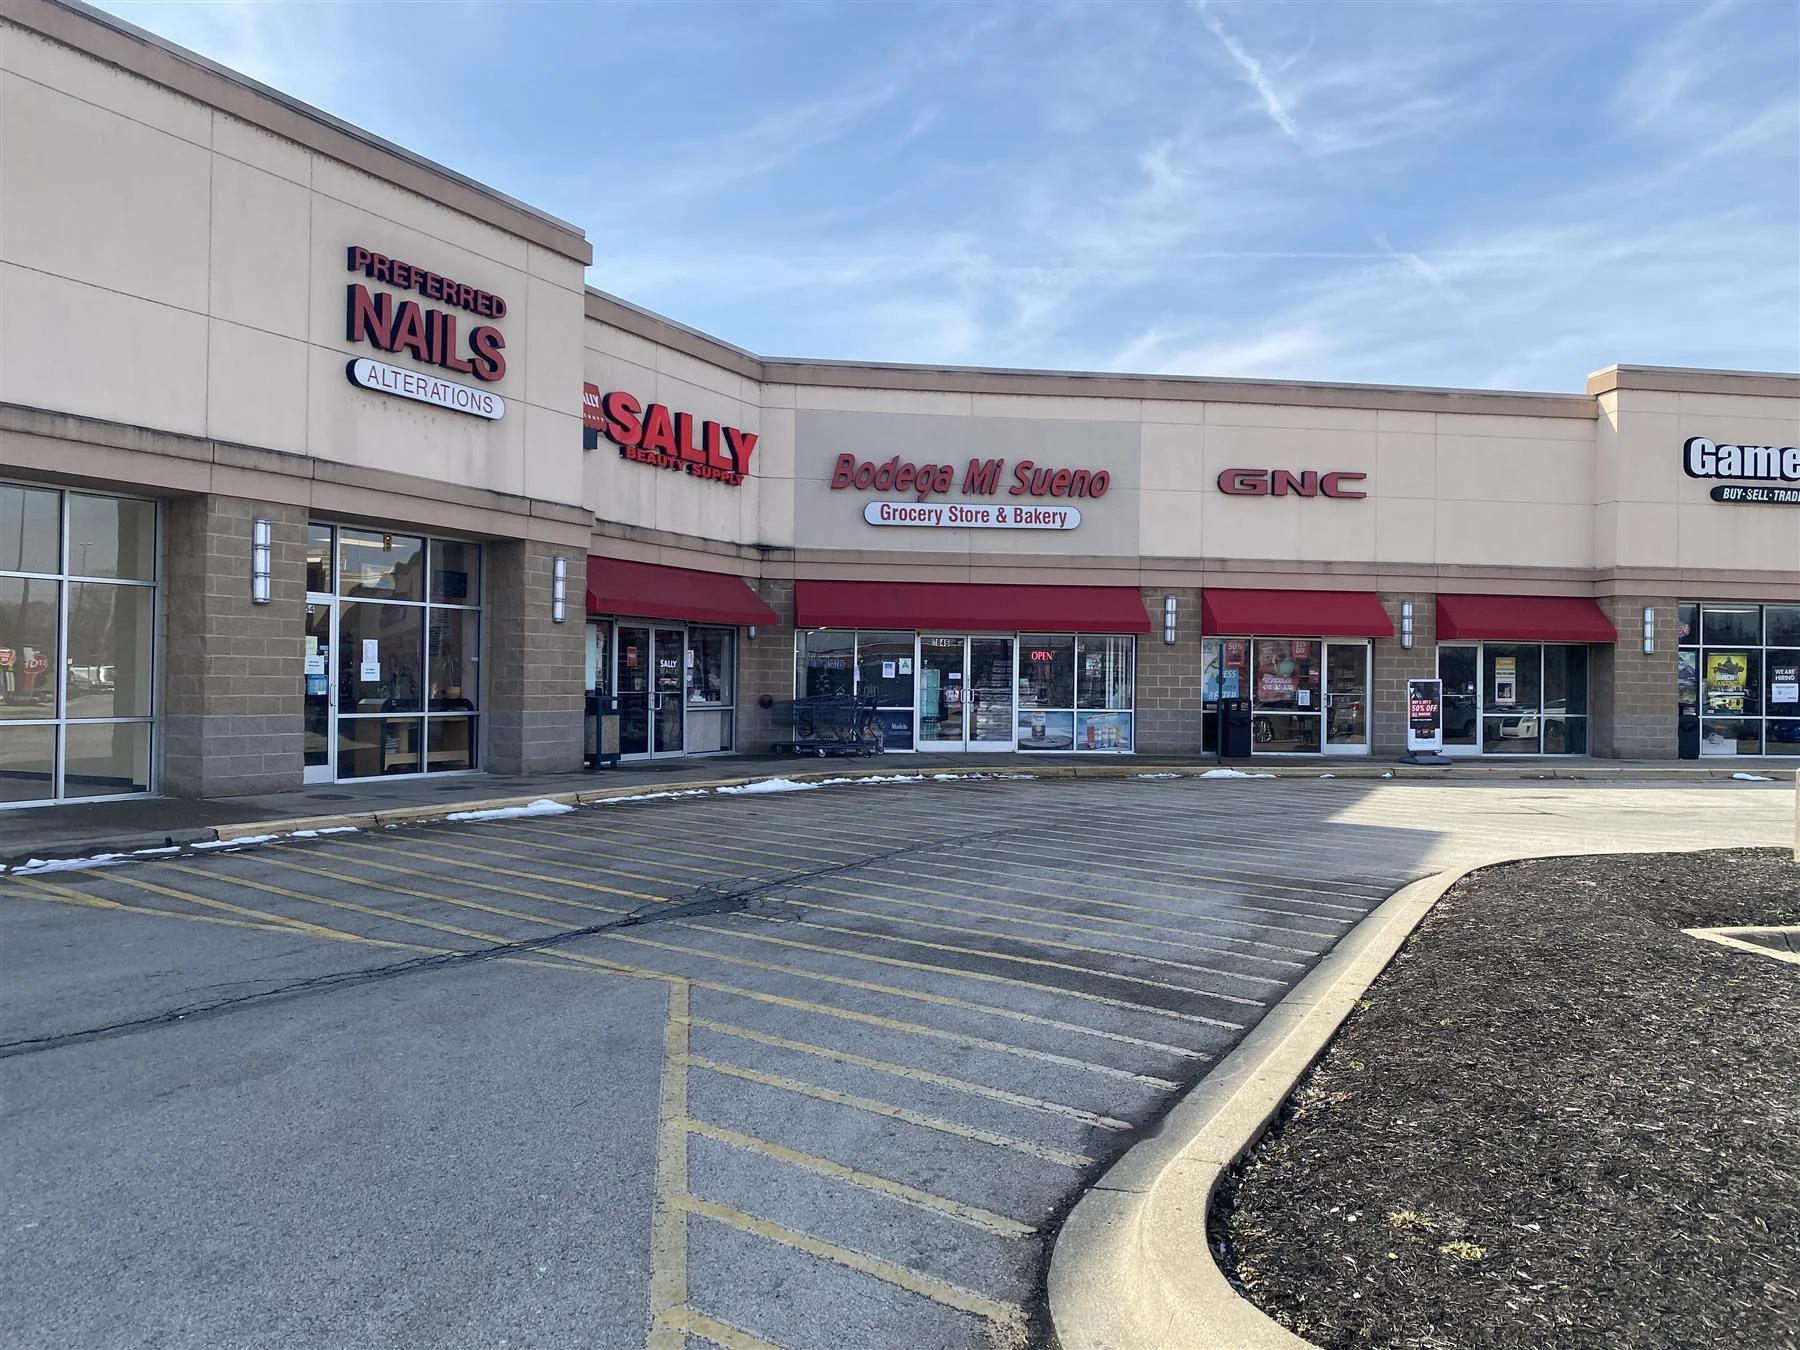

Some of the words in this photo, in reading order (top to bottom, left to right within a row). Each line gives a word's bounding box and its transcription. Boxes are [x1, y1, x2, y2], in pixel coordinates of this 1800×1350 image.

[348, 246, 507, 319] PREFERRED
[347, 284, 506, 381] NAILS
[367, 365, 494, 414] ALTERATIONS
[602, 391, 759, 475] SALLY
[620, 446, 687, 471] BEAUTY
[686, 462, 745, 487] SUPPLY
[831, 453, 955, 504] Bodega
[962, 458, 1005, 495] Mi
[1008, 460, 1110, 498] Sueno
[1683, 437, 1800, 482] Game
[1217, 468, 1368, 499] GNC
[880, 503, 943, 526] Grocery
[948, 506, 990, 523] Store
[996, 507, 1007, 524] &
[1013, 507, 1068, 528] Bakery
[660, 660, 678, 668] SALLY
[1031, 651, 1053, 661] OPEN
[1223, 670, 1237, 678] ESS
[1208, 690, 1237, 700] BETER
